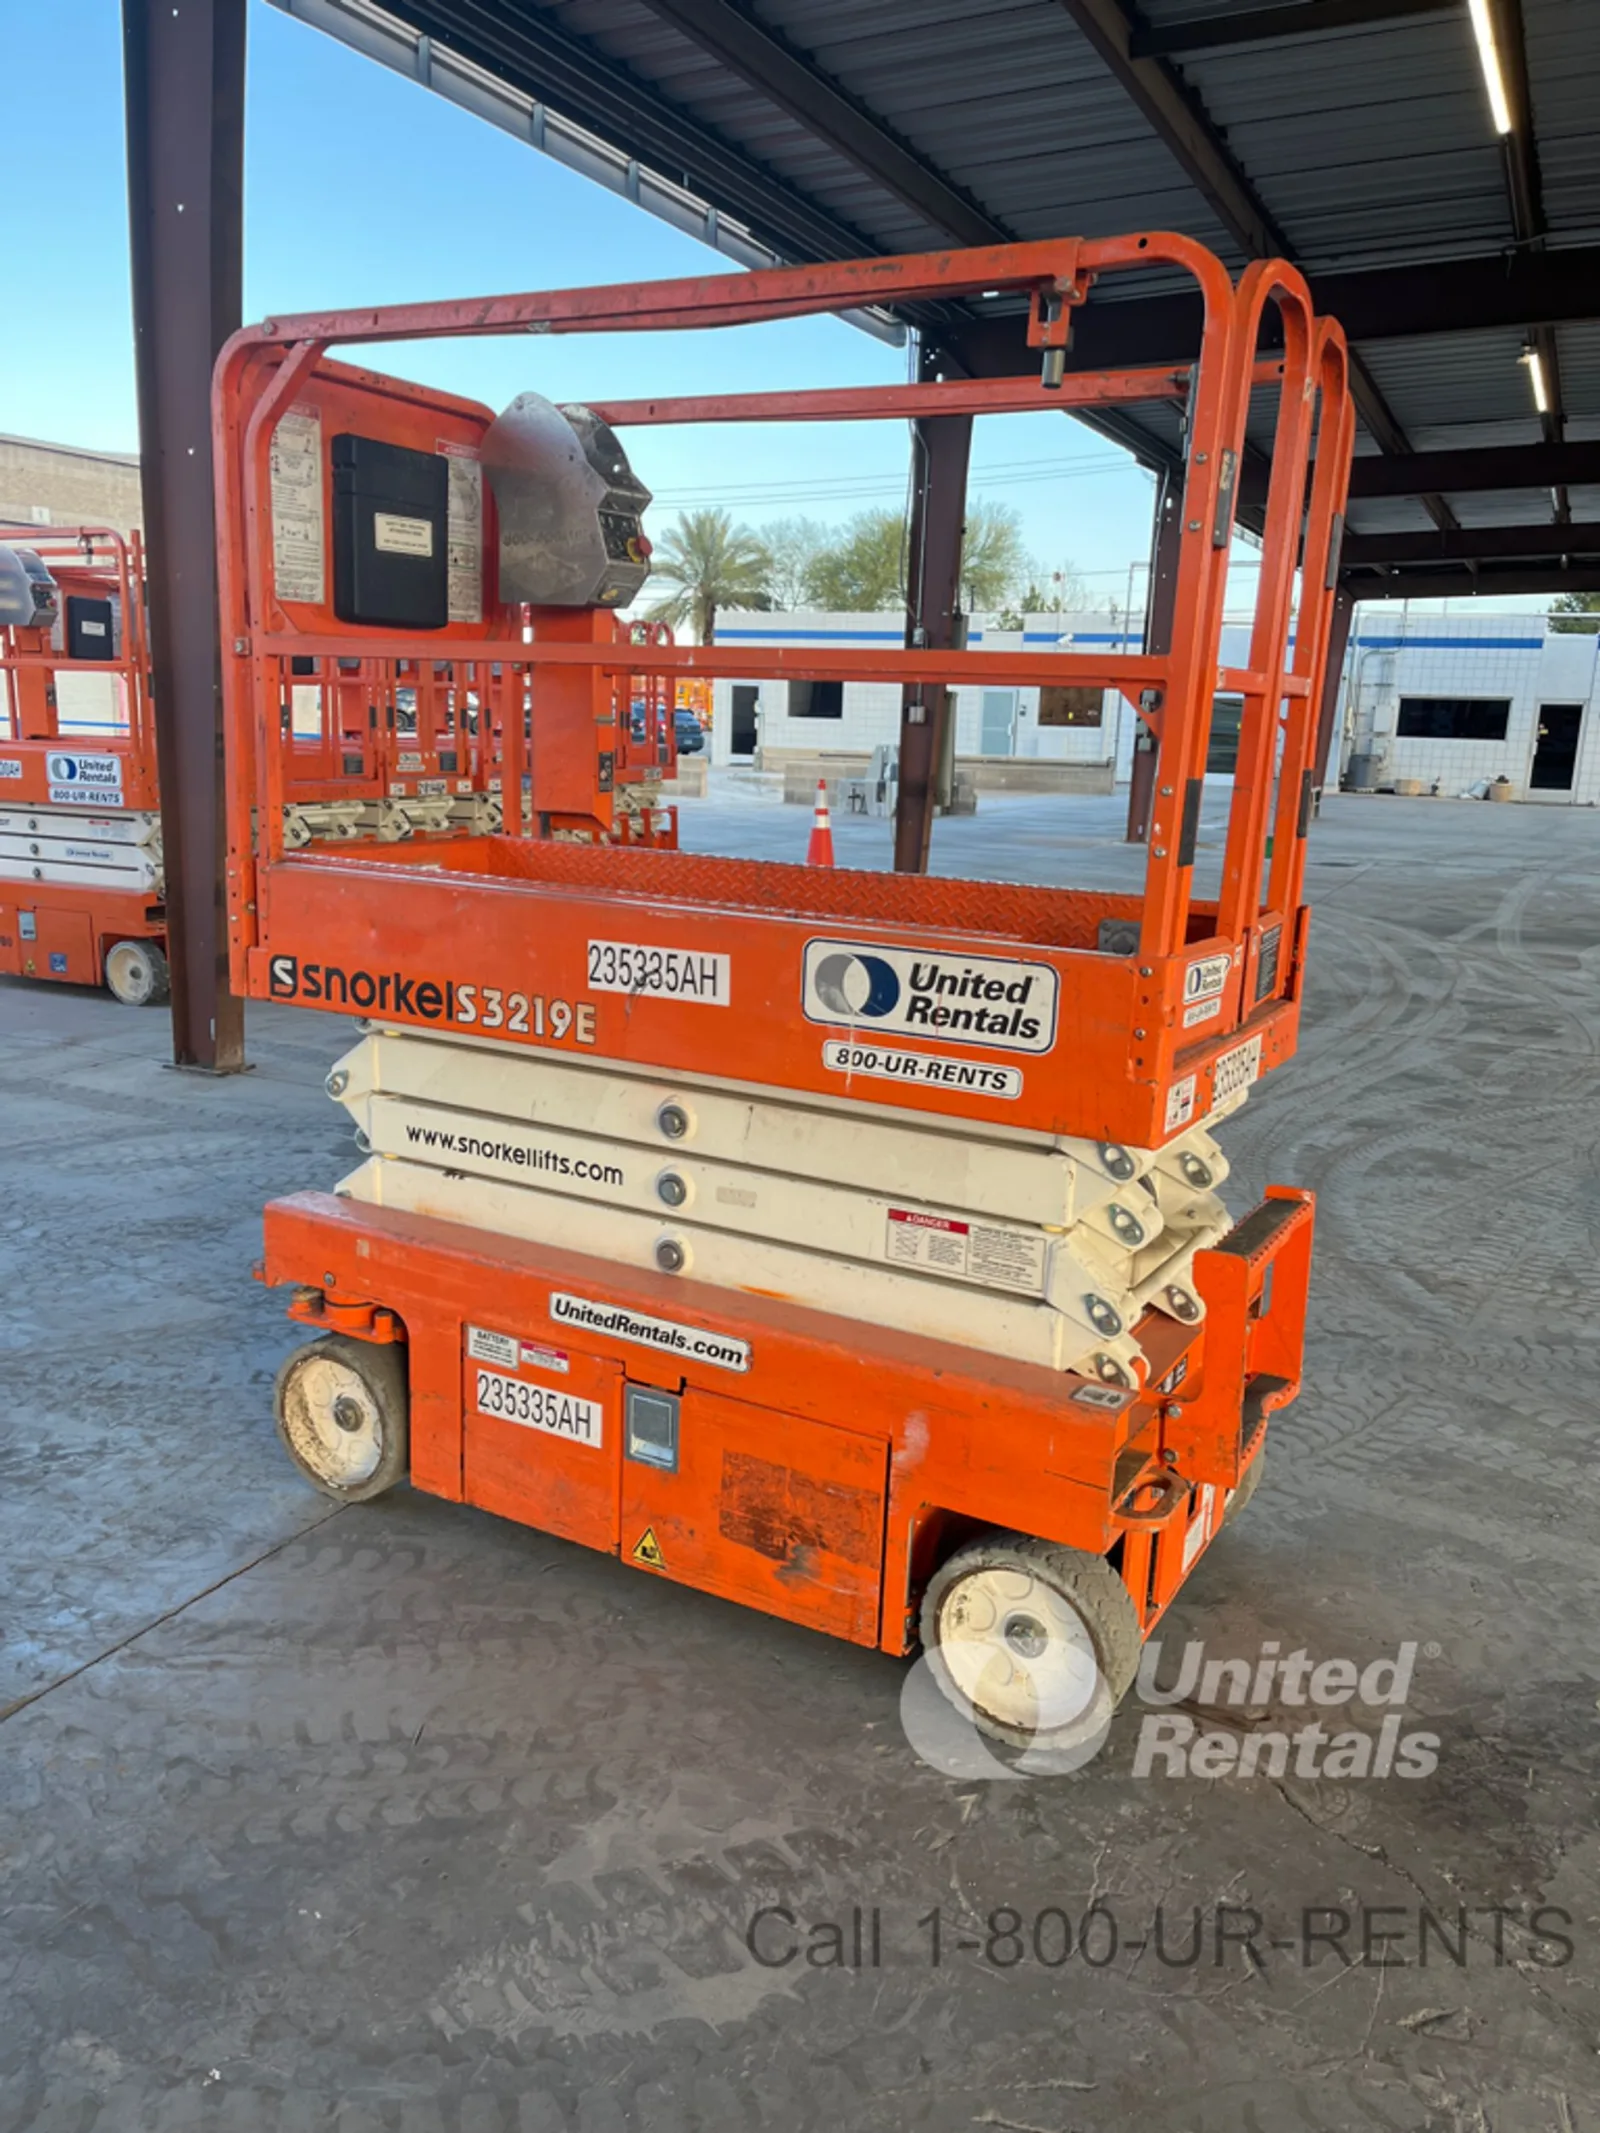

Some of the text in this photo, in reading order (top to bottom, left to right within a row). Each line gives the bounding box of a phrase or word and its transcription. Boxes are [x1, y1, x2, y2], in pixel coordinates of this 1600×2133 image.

[588, 943, 718, 997] 235335AH
[908, 962, 1034, 1004] United
[456, 984, 596, 1045] S3219E
[905, 995, 1041, 1039] Rentals
[835, 1047, 1008, 1091] 800-UR-RENTS
[405, 1124, 624, 1186] www.snorkellifts.com
[912, 1215, 950, 1230] DANGER
[554, 1298, 743, 1365] UnitedRentals.com
[478, 1373, 592, 1439] 235335AH
